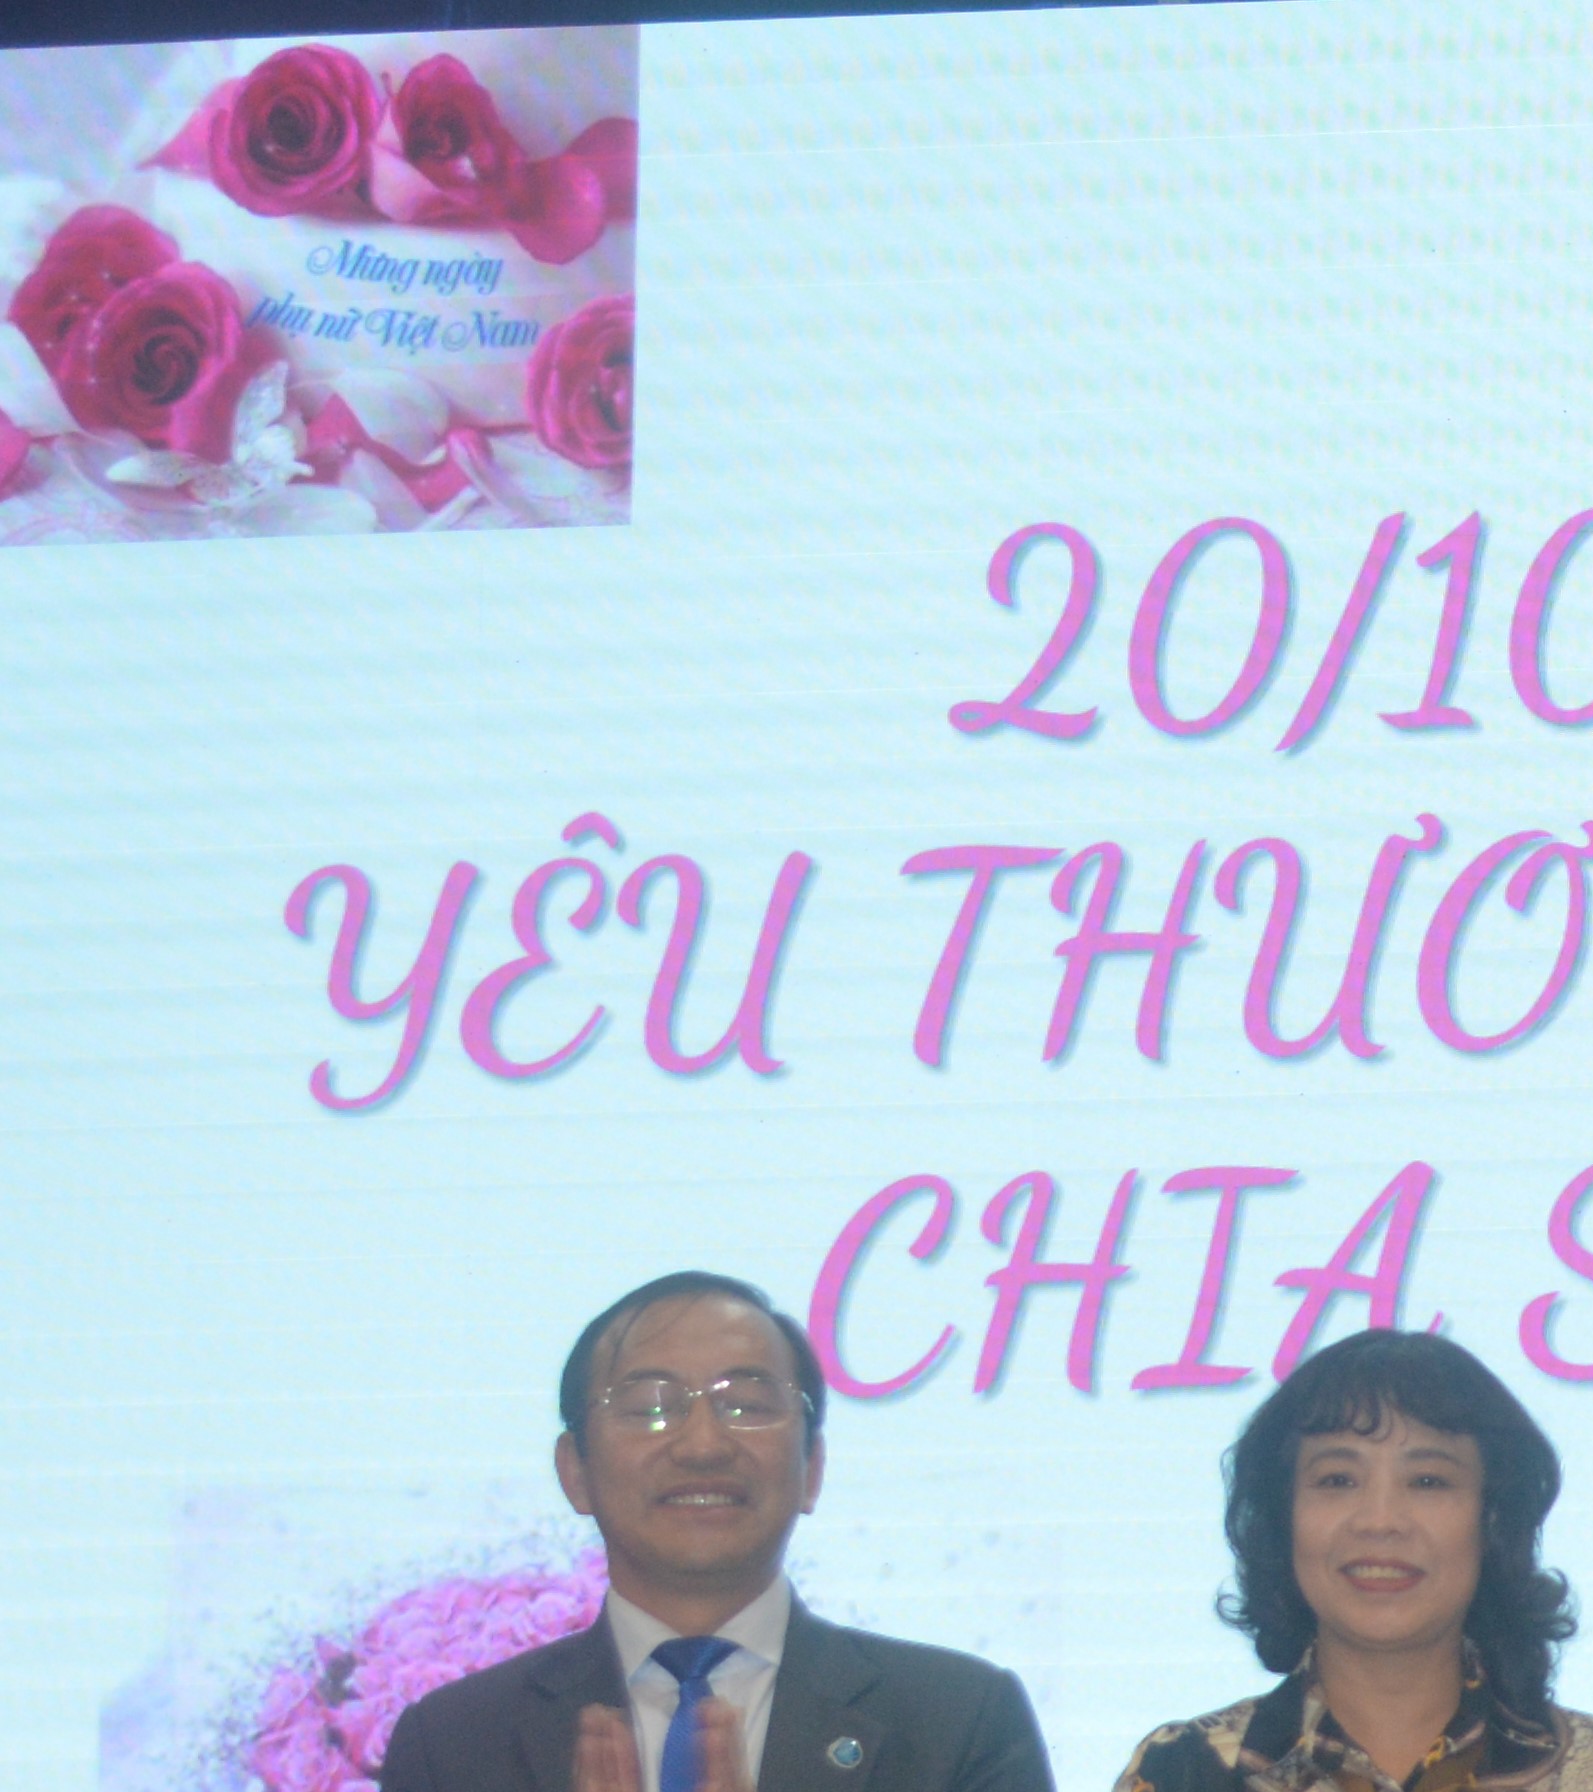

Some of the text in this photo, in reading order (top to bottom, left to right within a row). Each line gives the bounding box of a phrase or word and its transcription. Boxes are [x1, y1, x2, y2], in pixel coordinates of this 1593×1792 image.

[245, 291, 540, 355] phụ nữ Việt Nam
[422, 250, 504, 295] ngày
[283, 811, 816, 1112] YÊU
[807, 1160, 1447, 1399] CHIA
